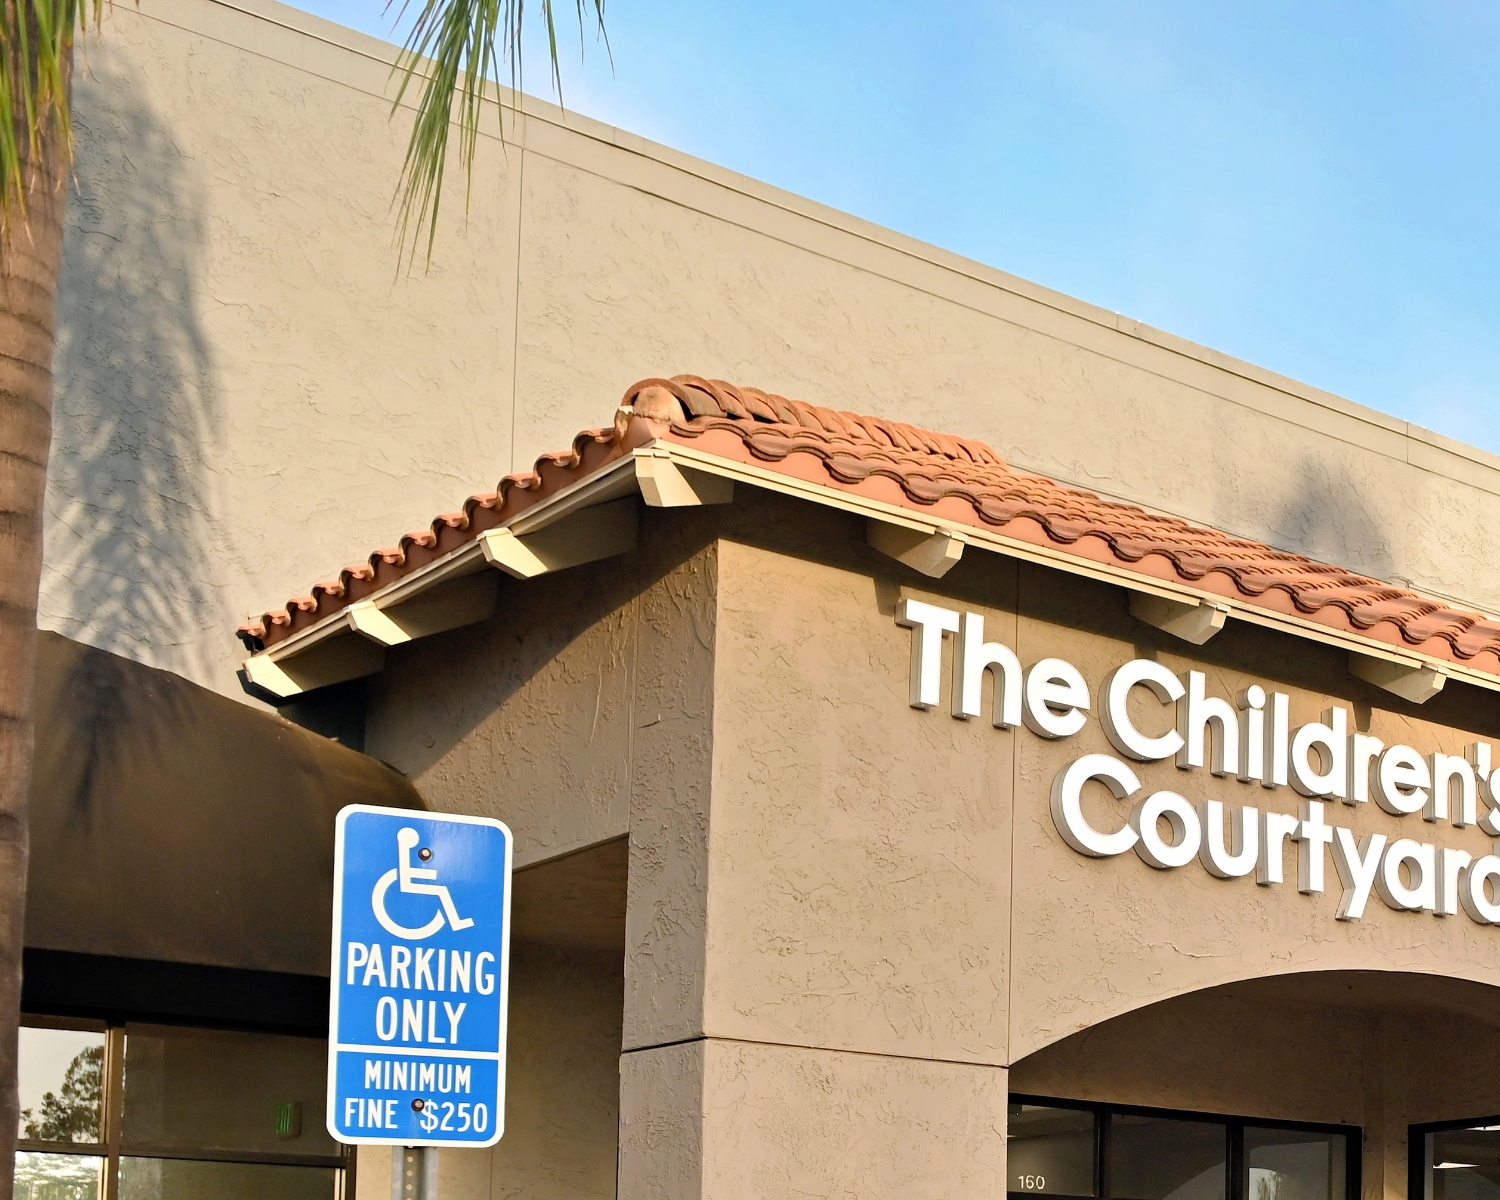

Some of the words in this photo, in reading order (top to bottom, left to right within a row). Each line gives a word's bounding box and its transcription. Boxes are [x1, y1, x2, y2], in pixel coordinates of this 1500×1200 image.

[894, 598, 1091, 739] The
[346, 941, 495, 996] PARKING
[375, 996, 467, 1045] ONLY
[363, 1059, 472, 1094] MINIMUM
[344, 1097, 399, 1129] FINE
[420, 1099, 488, 1134] $250
[1017, 1174, 1045, 1190] 160
